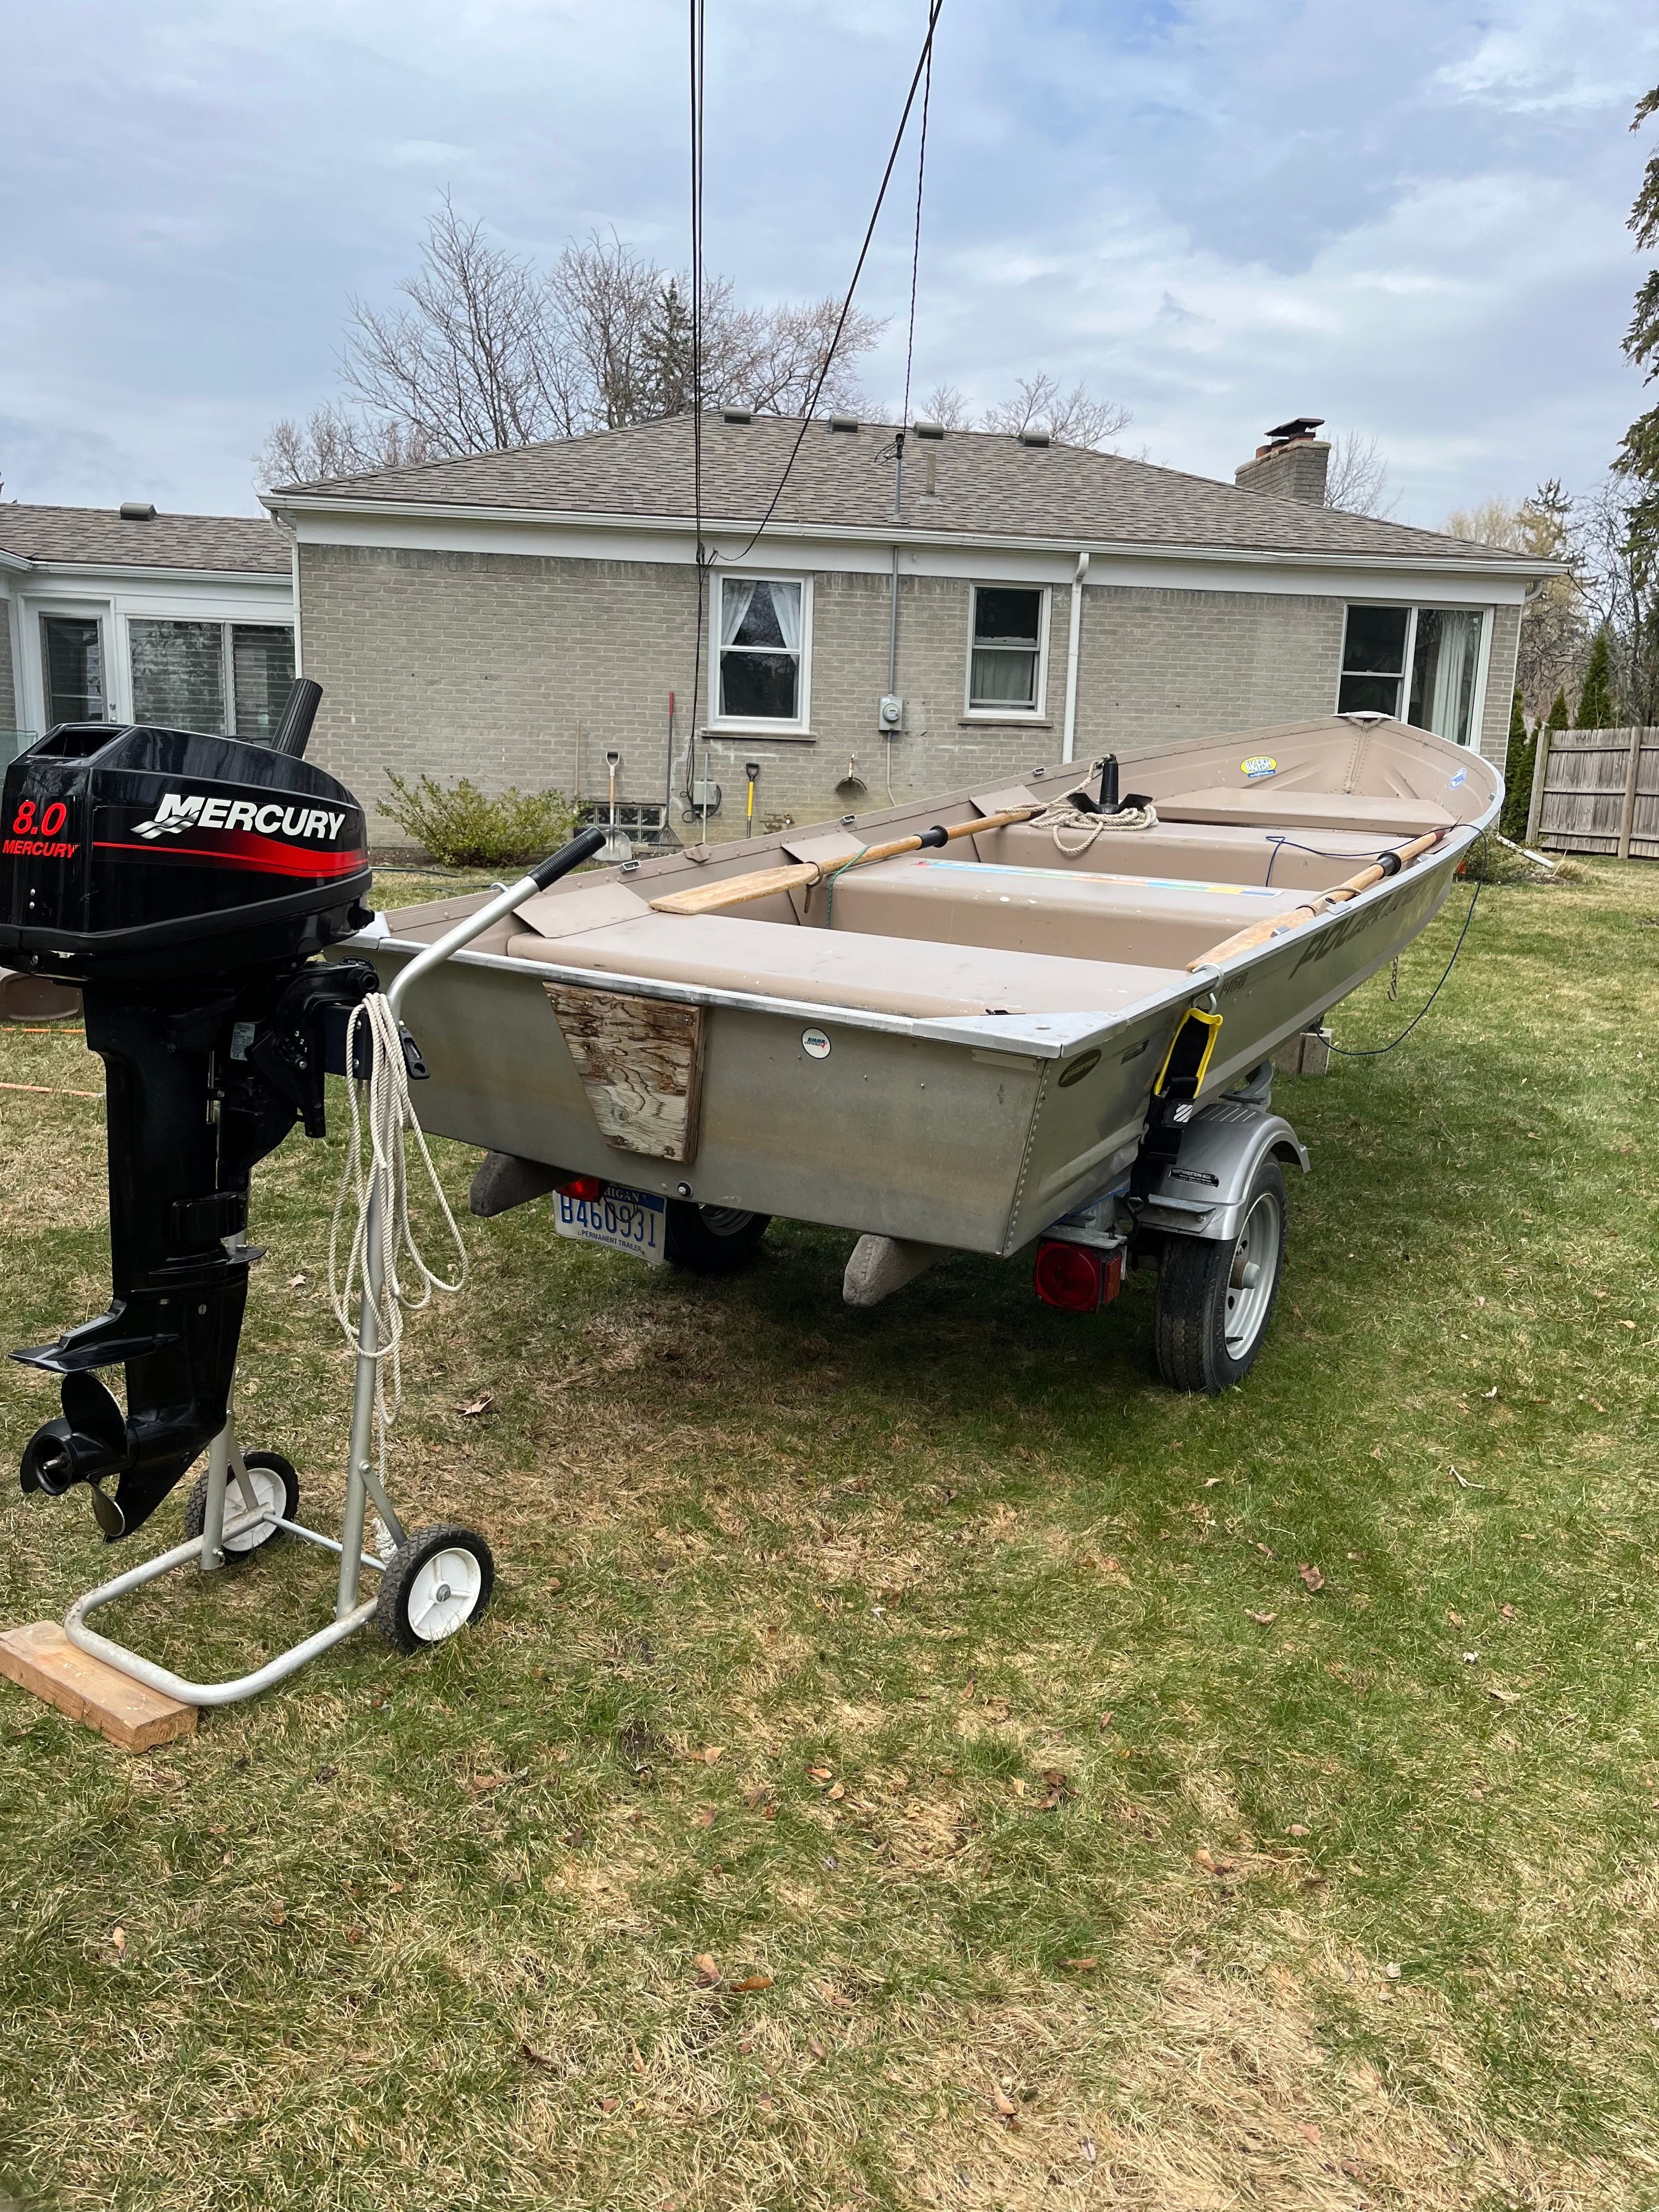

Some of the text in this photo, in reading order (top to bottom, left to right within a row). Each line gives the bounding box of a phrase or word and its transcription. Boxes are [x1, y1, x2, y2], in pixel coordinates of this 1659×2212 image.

[13, 800, 66, 836] 8.0
[154, 793, 346, 840] MERCURY
[2, 839, 79, 858] MERCURY
[604, 1187, 639, 1203] HIGAN
[560, 1194, 656, 1248] B460931
[581, 1229, 641, 1252] PERMANENT TRAILER
